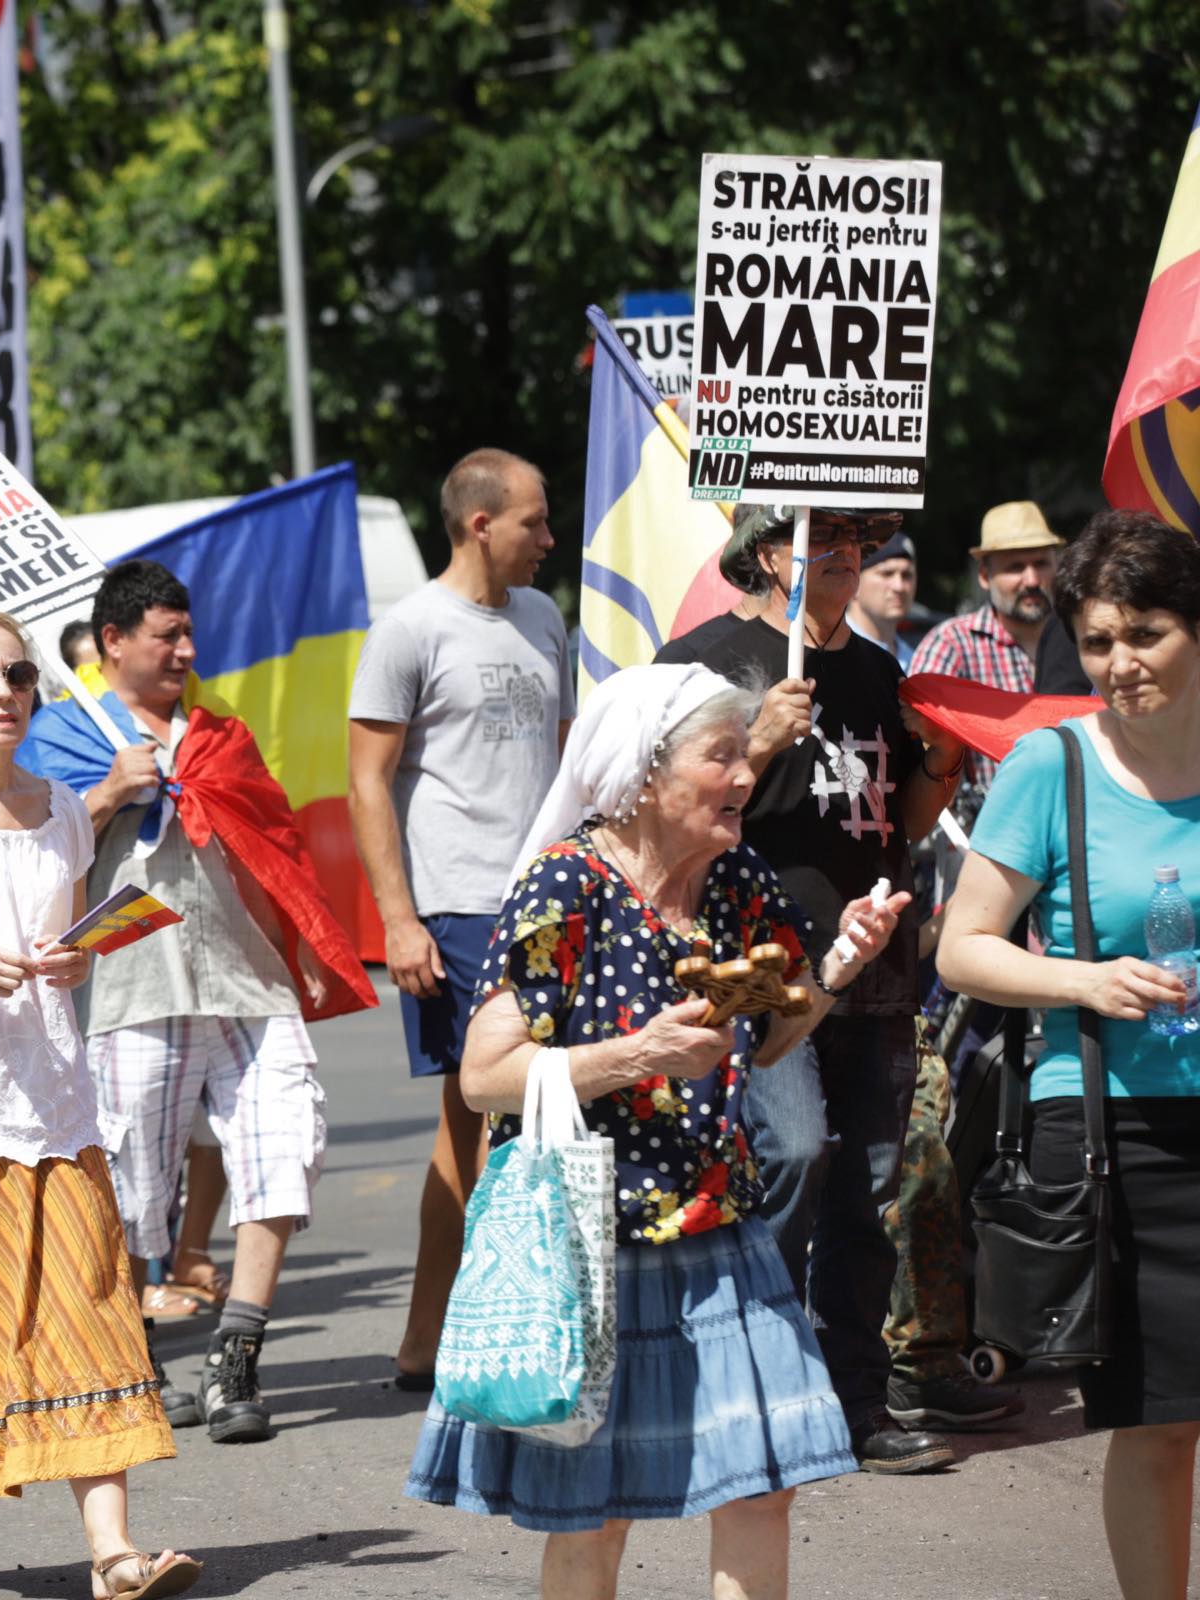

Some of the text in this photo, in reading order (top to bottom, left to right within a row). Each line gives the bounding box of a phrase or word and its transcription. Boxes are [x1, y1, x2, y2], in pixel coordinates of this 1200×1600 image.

[711, 215, 927, 250] s-au jertfit pentru
[705, 244, 931, 304] ROMÂNIA
[701, 301, 930, 381] MARE
[697, 380, 923, 410] NU pentru căsătorii
[696, 409, 922, 443] HOMOSEXUALE!
[703, 439, 749, 450] NOUA
[698, 452, 745, 487] ND
[750, 461, 919, 485] #PentruNormalitate
